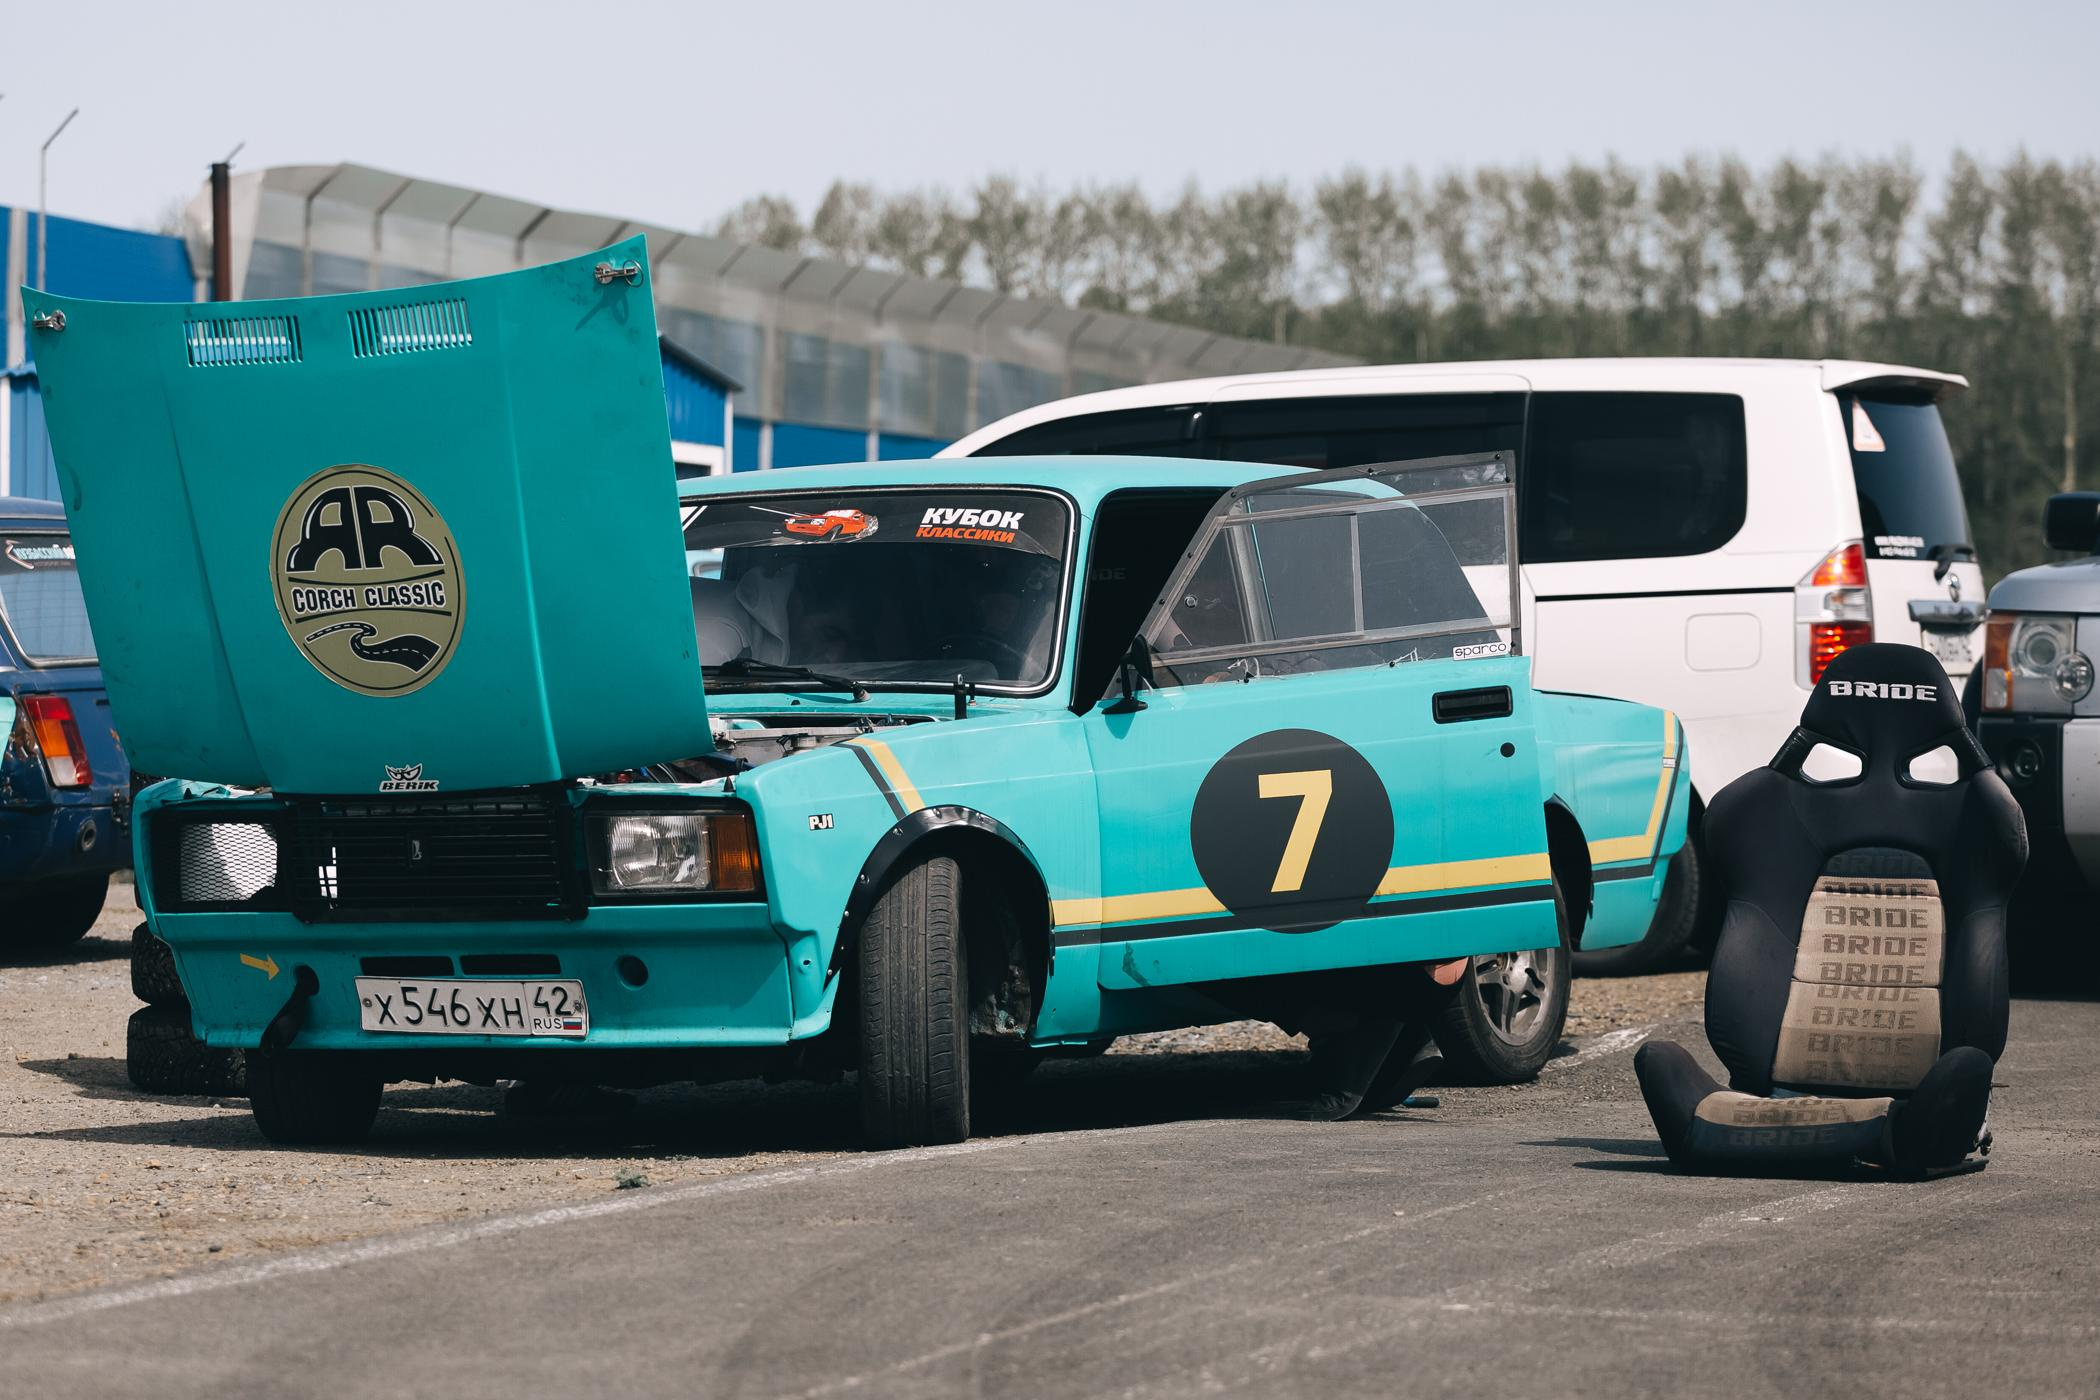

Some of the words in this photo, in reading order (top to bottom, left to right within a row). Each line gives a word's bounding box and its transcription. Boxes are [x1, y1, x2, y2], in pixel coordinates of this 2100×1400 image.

[921, 508, 1025, 530] КУБОК
[915, 527, 1016, 543] КЛАССИКИ
[291, 587, 357, 614] CORCH
[364, 580, 446, 608] CLASSIC
[1455, 643, 1507, 659] sparco
[1828, 681, 1937, 702] BRIDE
[809, 814, 834, 830] PJ1
[1258, 769, 1333, 893] 7
[1823, 906, 1929, 928] BRIDE
[1822, 934, 1928, 956] BRIDE
[1819, 962, 1925, 984] BRIDE
[532, 986, 573, 1016] 42
[534, 1016, 563, 1030] RUS
[1811, 1006, 1918, 1030] BRIDE
